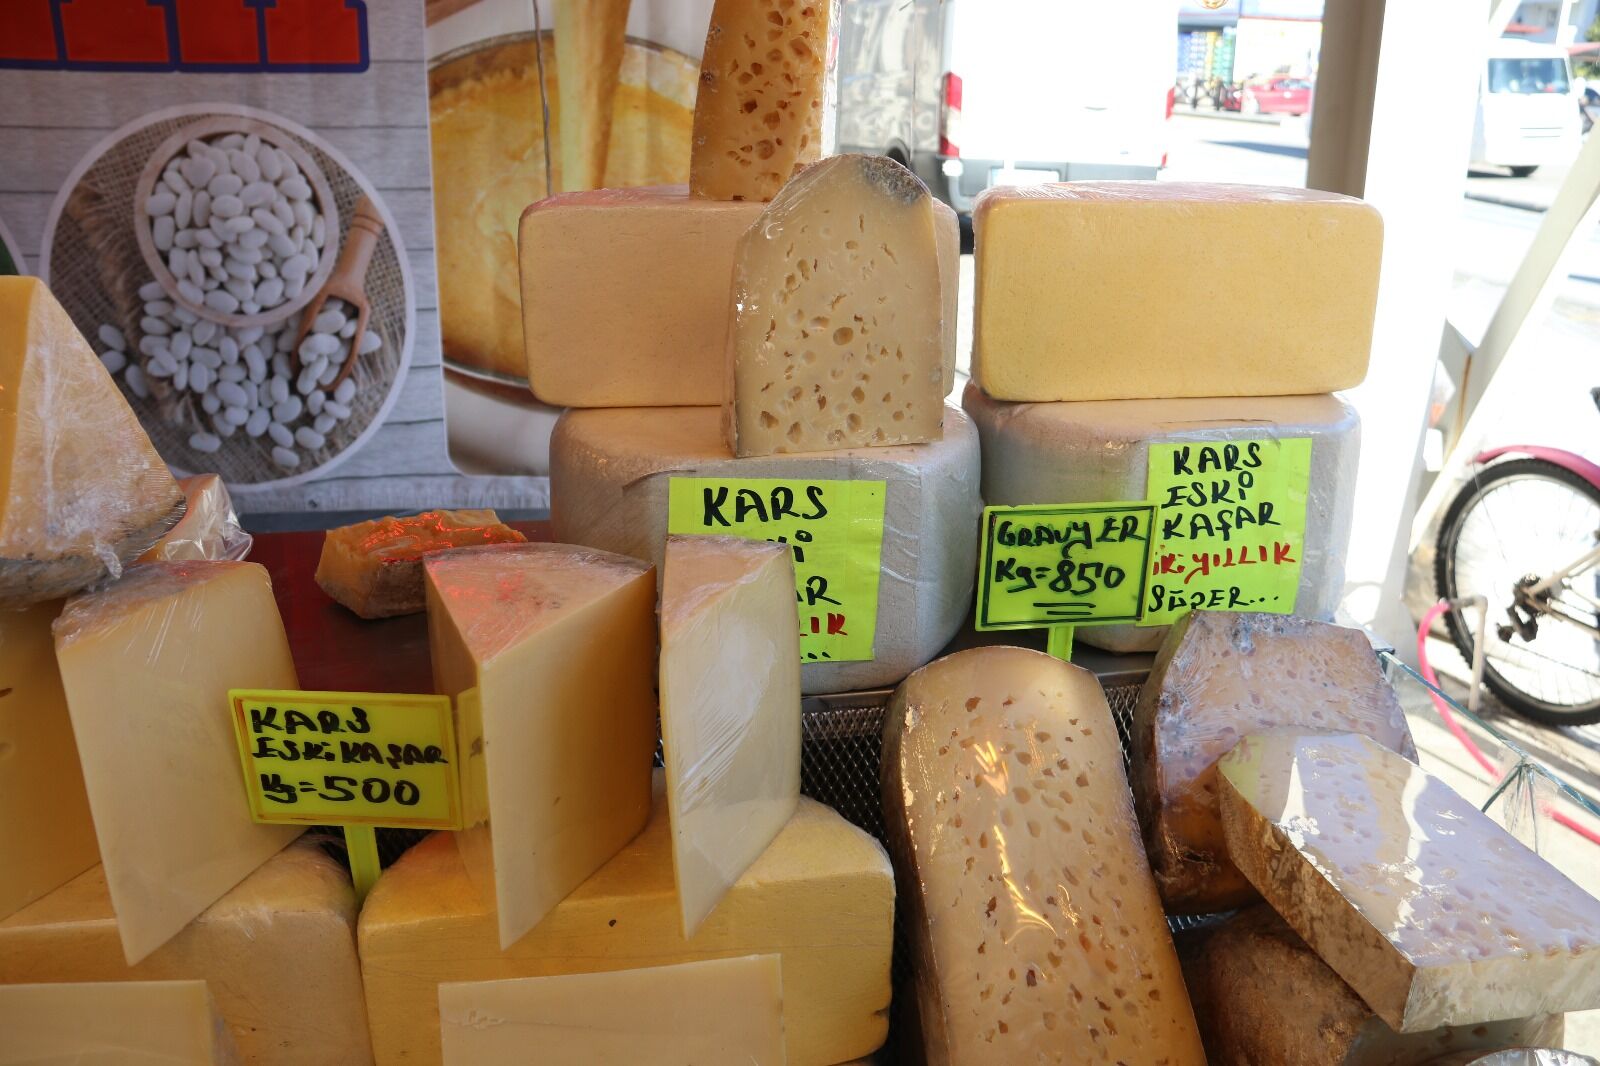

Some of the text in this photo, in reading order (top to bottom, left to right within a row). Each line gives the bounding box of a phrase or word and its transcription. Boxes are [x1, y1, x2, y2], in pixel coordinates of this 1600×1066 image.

[1173, 442, 1262, 475] KARS
[703, 485, 828, 527] KARS
[997, 515, 1147, 559] GRAVYER
[994, 557, 1126, 596] Kg=850
[250, 706, 371, 735] KARS
